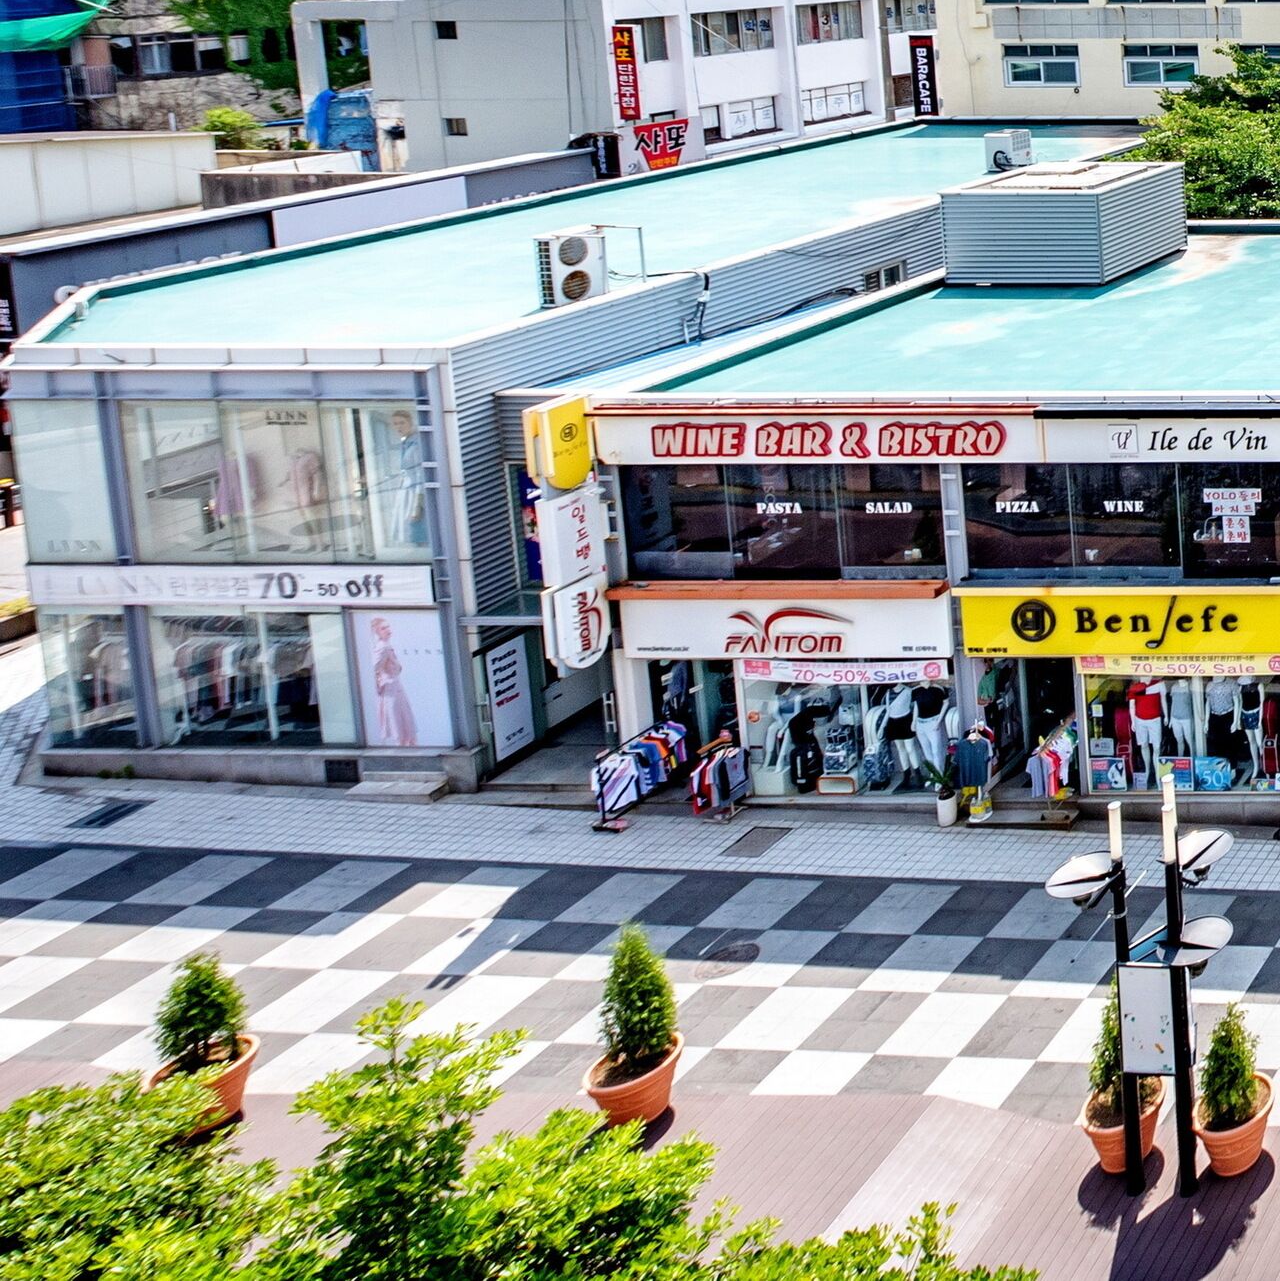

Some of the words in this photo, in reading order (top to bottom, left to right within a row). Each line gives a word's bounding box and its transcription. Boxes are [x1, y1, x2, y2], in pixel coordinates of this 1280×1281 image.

[634, 123, 687, 153] 샤또
[651, 422, 747, 457] WINE
[755, 421, 832, 457] BAR
[840, 422, 871, 459] &
[878, 421, 1007, 457] BISTRO
[1147, 428, 1178, 451] Ile
[1188, 428, 1212, 451] de
[1222, 428, 1268, 450] Vin
[756, 502, 803, 514] PASTA
[865, 502, 913, 514] SALAD
[995, 501, 1040, 513] PIZZA
[1103, 500, 1145, 513] WINE
[576, 591, 593, 652] FANTOM
[724, 634, 843, 654] FANTOM
[490, 647, 517, 666] Pasta
[492, 659, 518, 676] Pizza
[792, 669, 871, 682] 70~50%
[873, 670, 918, 682] Sale
[1213, 663, 1256, 674] Sale
[495, 691, 520, 708] Wine
[1202, 771, 1224, 787] 50
